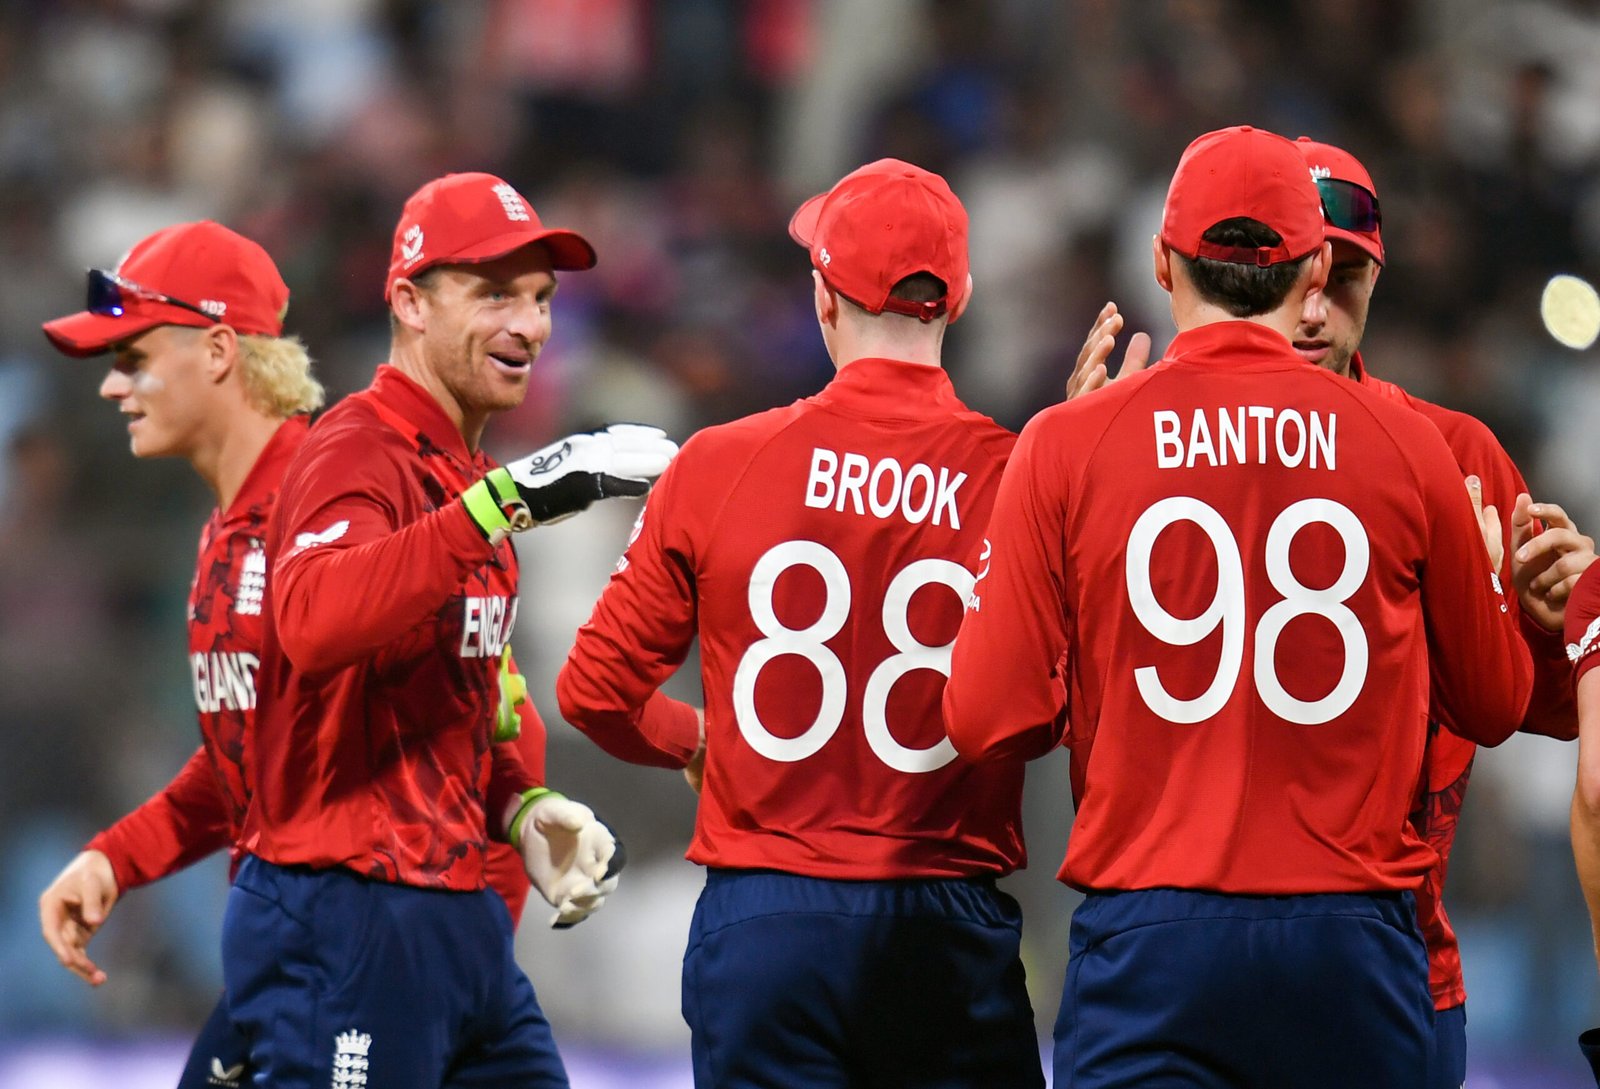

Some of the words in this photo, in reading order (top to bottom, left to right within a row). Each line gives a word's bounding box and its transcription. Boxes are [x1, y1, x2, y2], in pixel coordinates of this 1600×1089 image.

[405, 224, 420, 244] 100
[1153, 405, 1336, 471] BANTON
[804, 447, 968, 530] BROOK
[1126, 496, 1370, 725] 98
[733, 540, 977, 773] 88
